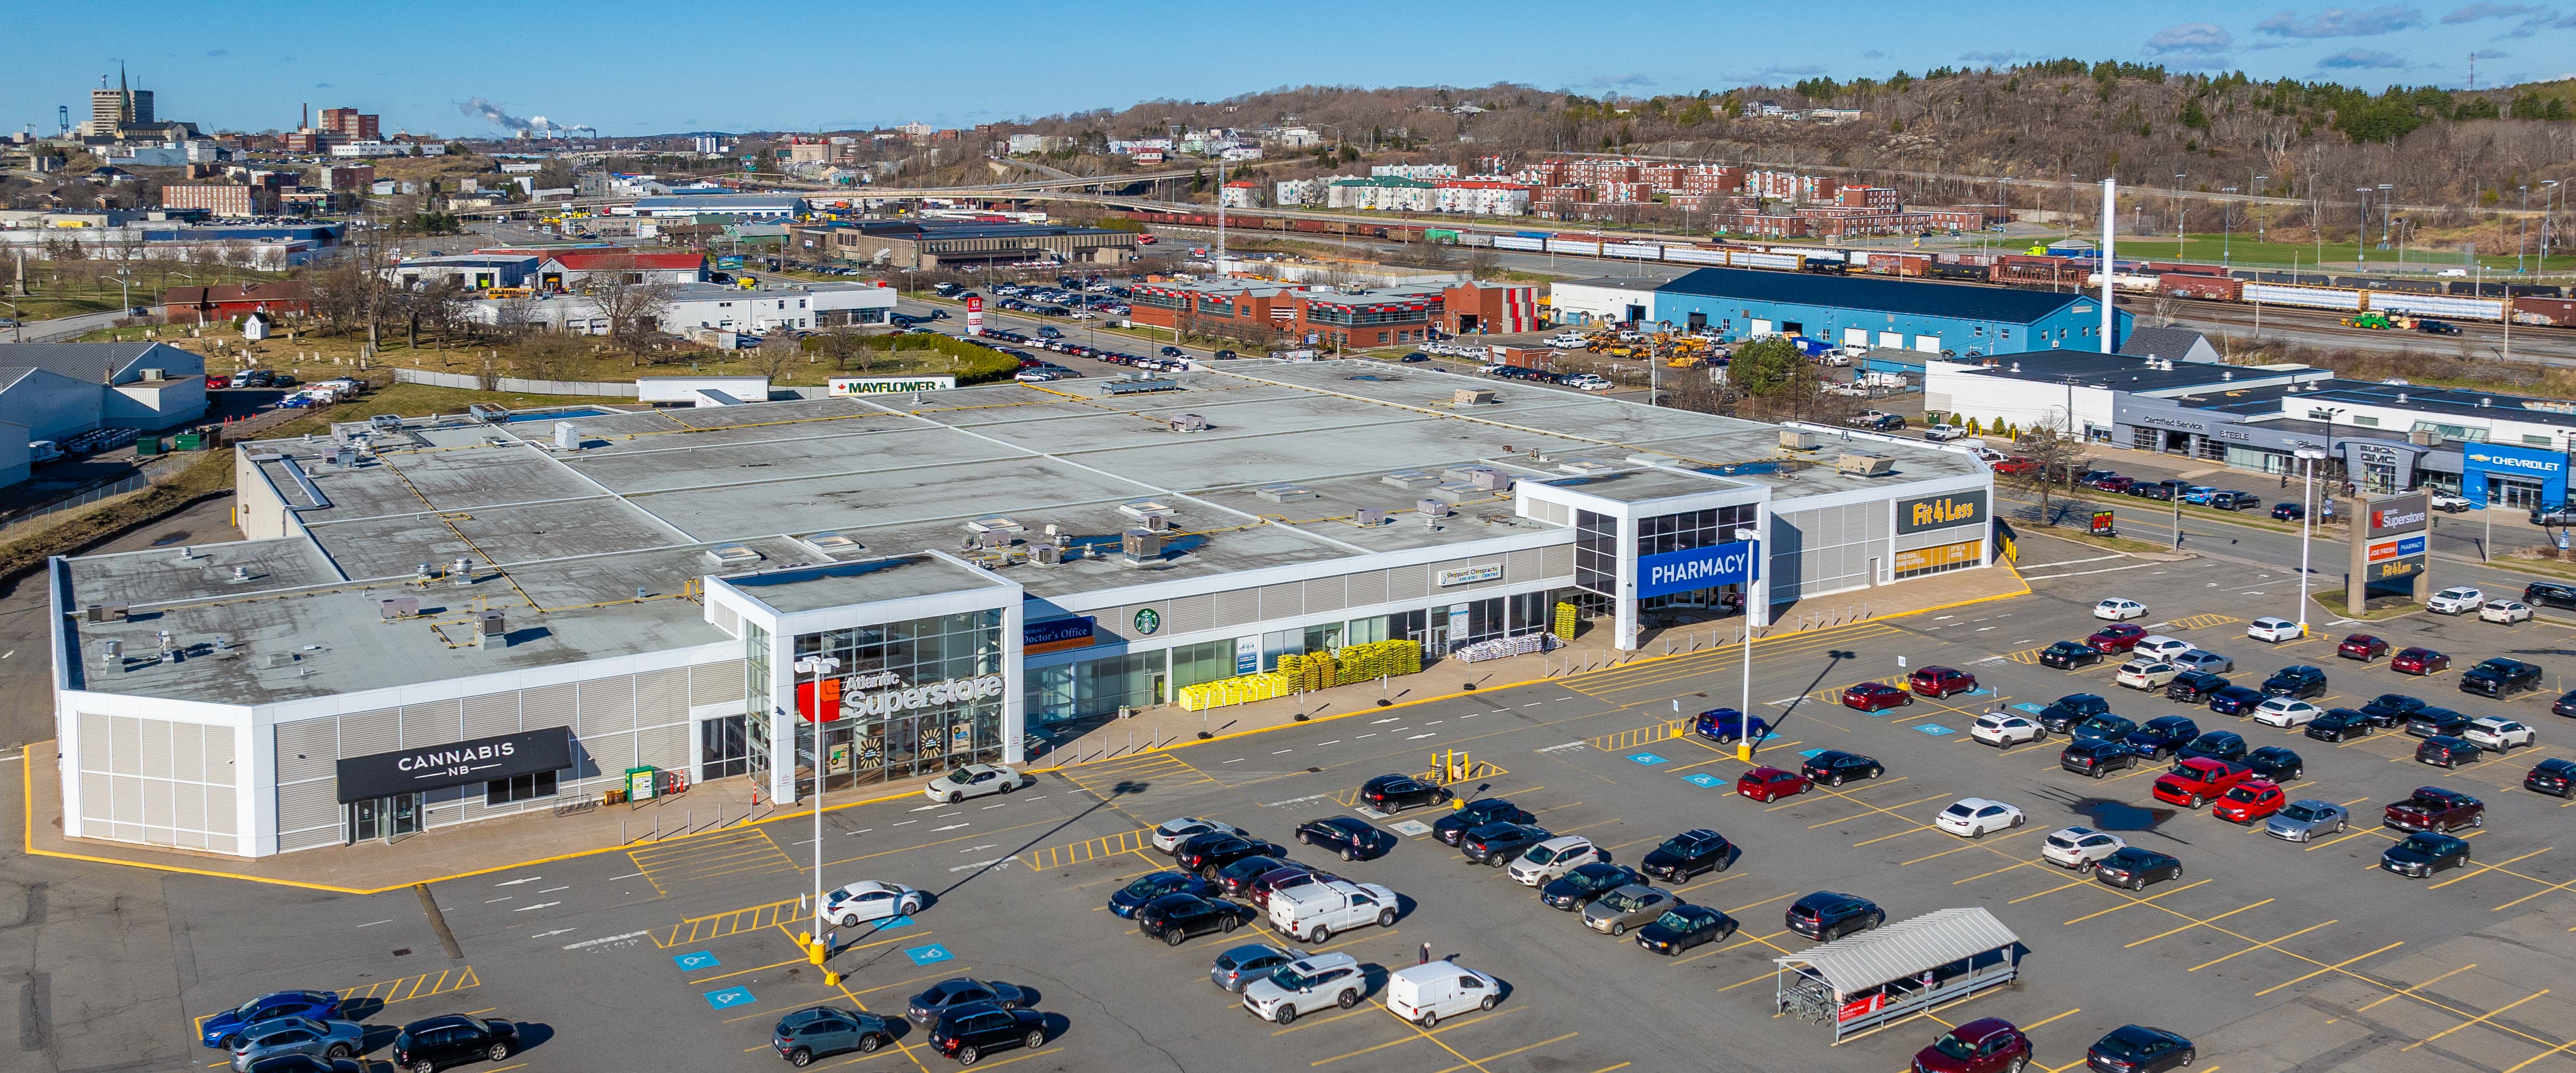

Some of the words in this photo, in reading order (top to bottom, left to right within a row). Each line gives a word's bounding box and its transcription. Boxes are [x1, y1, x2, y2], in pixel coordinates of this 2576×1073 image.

[849, 381, 936, 393] MAYFLOWER
[2144, 416, 2174, 426] Certified
[2177, 421, 2204, 430] Service
[2220, 431, 2249, 440] STEELE
[2360, 445, 2397, 455] BUICK
[2361, 453, 2397, 464] GMC
[2492, 456, 2559, 471] CHEVROLET
[1913, 502, 1933, 526] Fit
[1934, 499, 1944, 523] 4
[1945, 498, 1973, 521] Less
[2383, 512, 2425, 528] Superstore
[2380, 546, 2395, 555] FRESH
[2400, 542, 2422, 550] PHARMACY
[1447, 570, 1469, 578] Sheppard
[1653, 554, 1746, 585] PHARMACY
[2382, 564, 2392, 577] Fit
[2392, 562, 2397, 575] 4
[1061, 627, 1087, 638] Office
[845, 672, 900, 691] Atlantic
[845, 676, 1002, 720] Superstore
[398, 743, 514, 770] CANNABIS
[448, 766, 469, 776] NB
